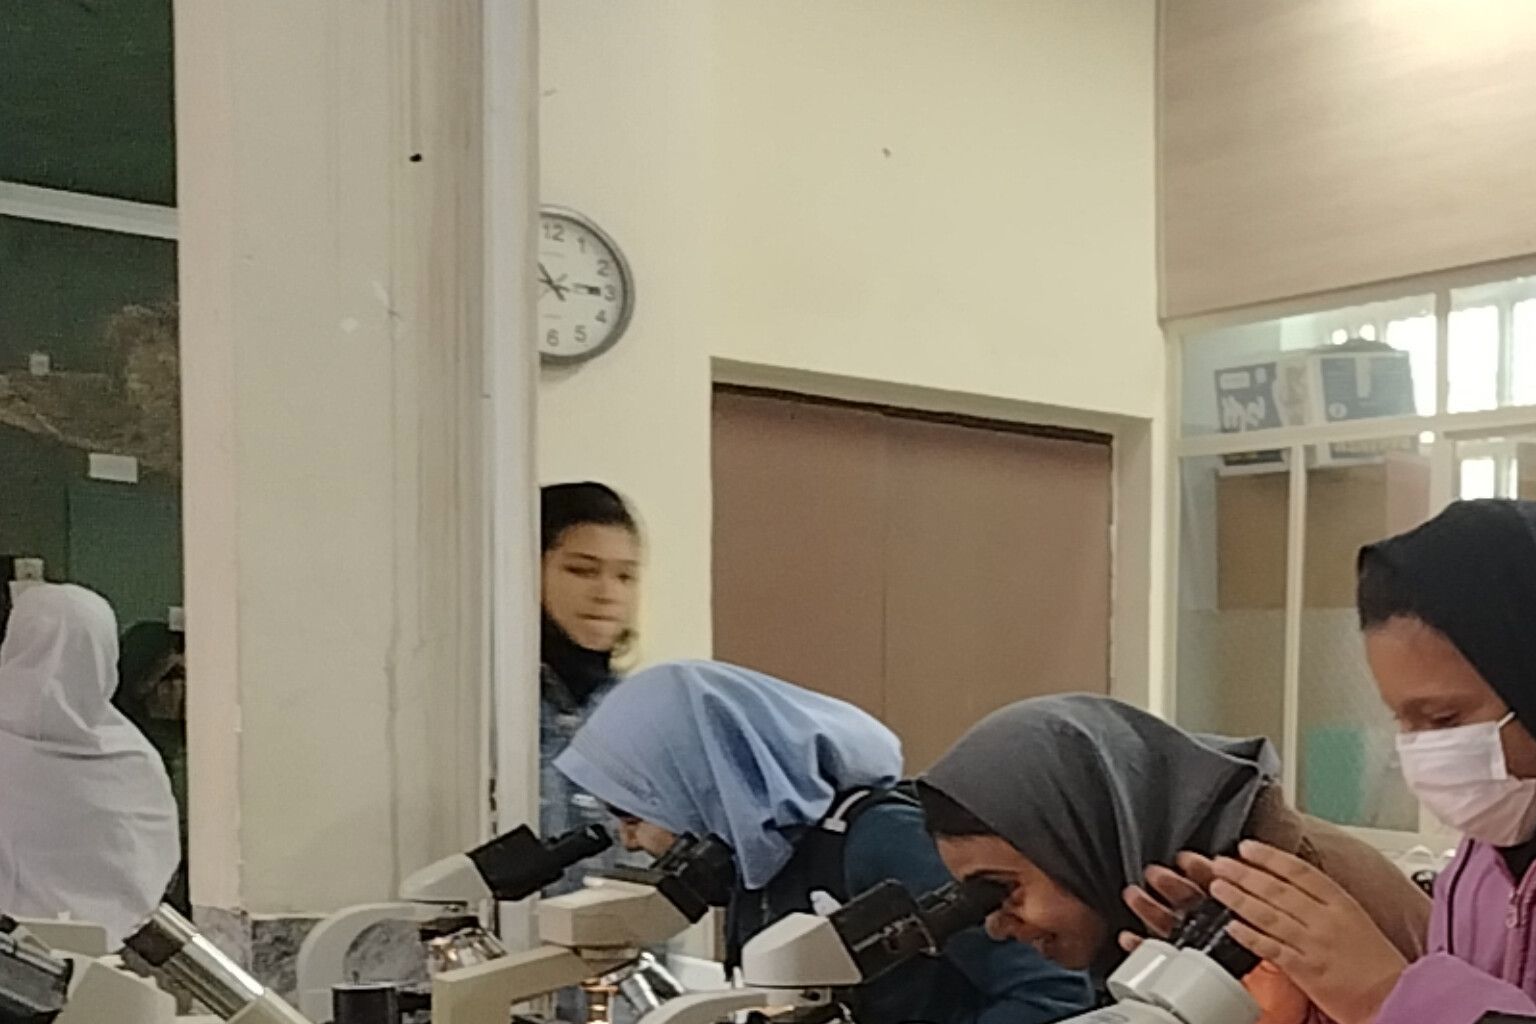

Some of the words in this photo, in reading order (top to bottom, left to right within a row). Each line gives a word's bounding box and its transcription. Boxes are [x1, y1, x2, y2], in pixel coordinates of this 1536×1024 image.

[542, 223, 565, 243] 12
[577, 236, 586, 253] 1
[596, 259, 610, 277] 2
[604, 284, 616, 301] 3
[595, 309, 607, 323] 4
[546, 328, 560, 347] 6
[574, 325, 587, 343] 5
